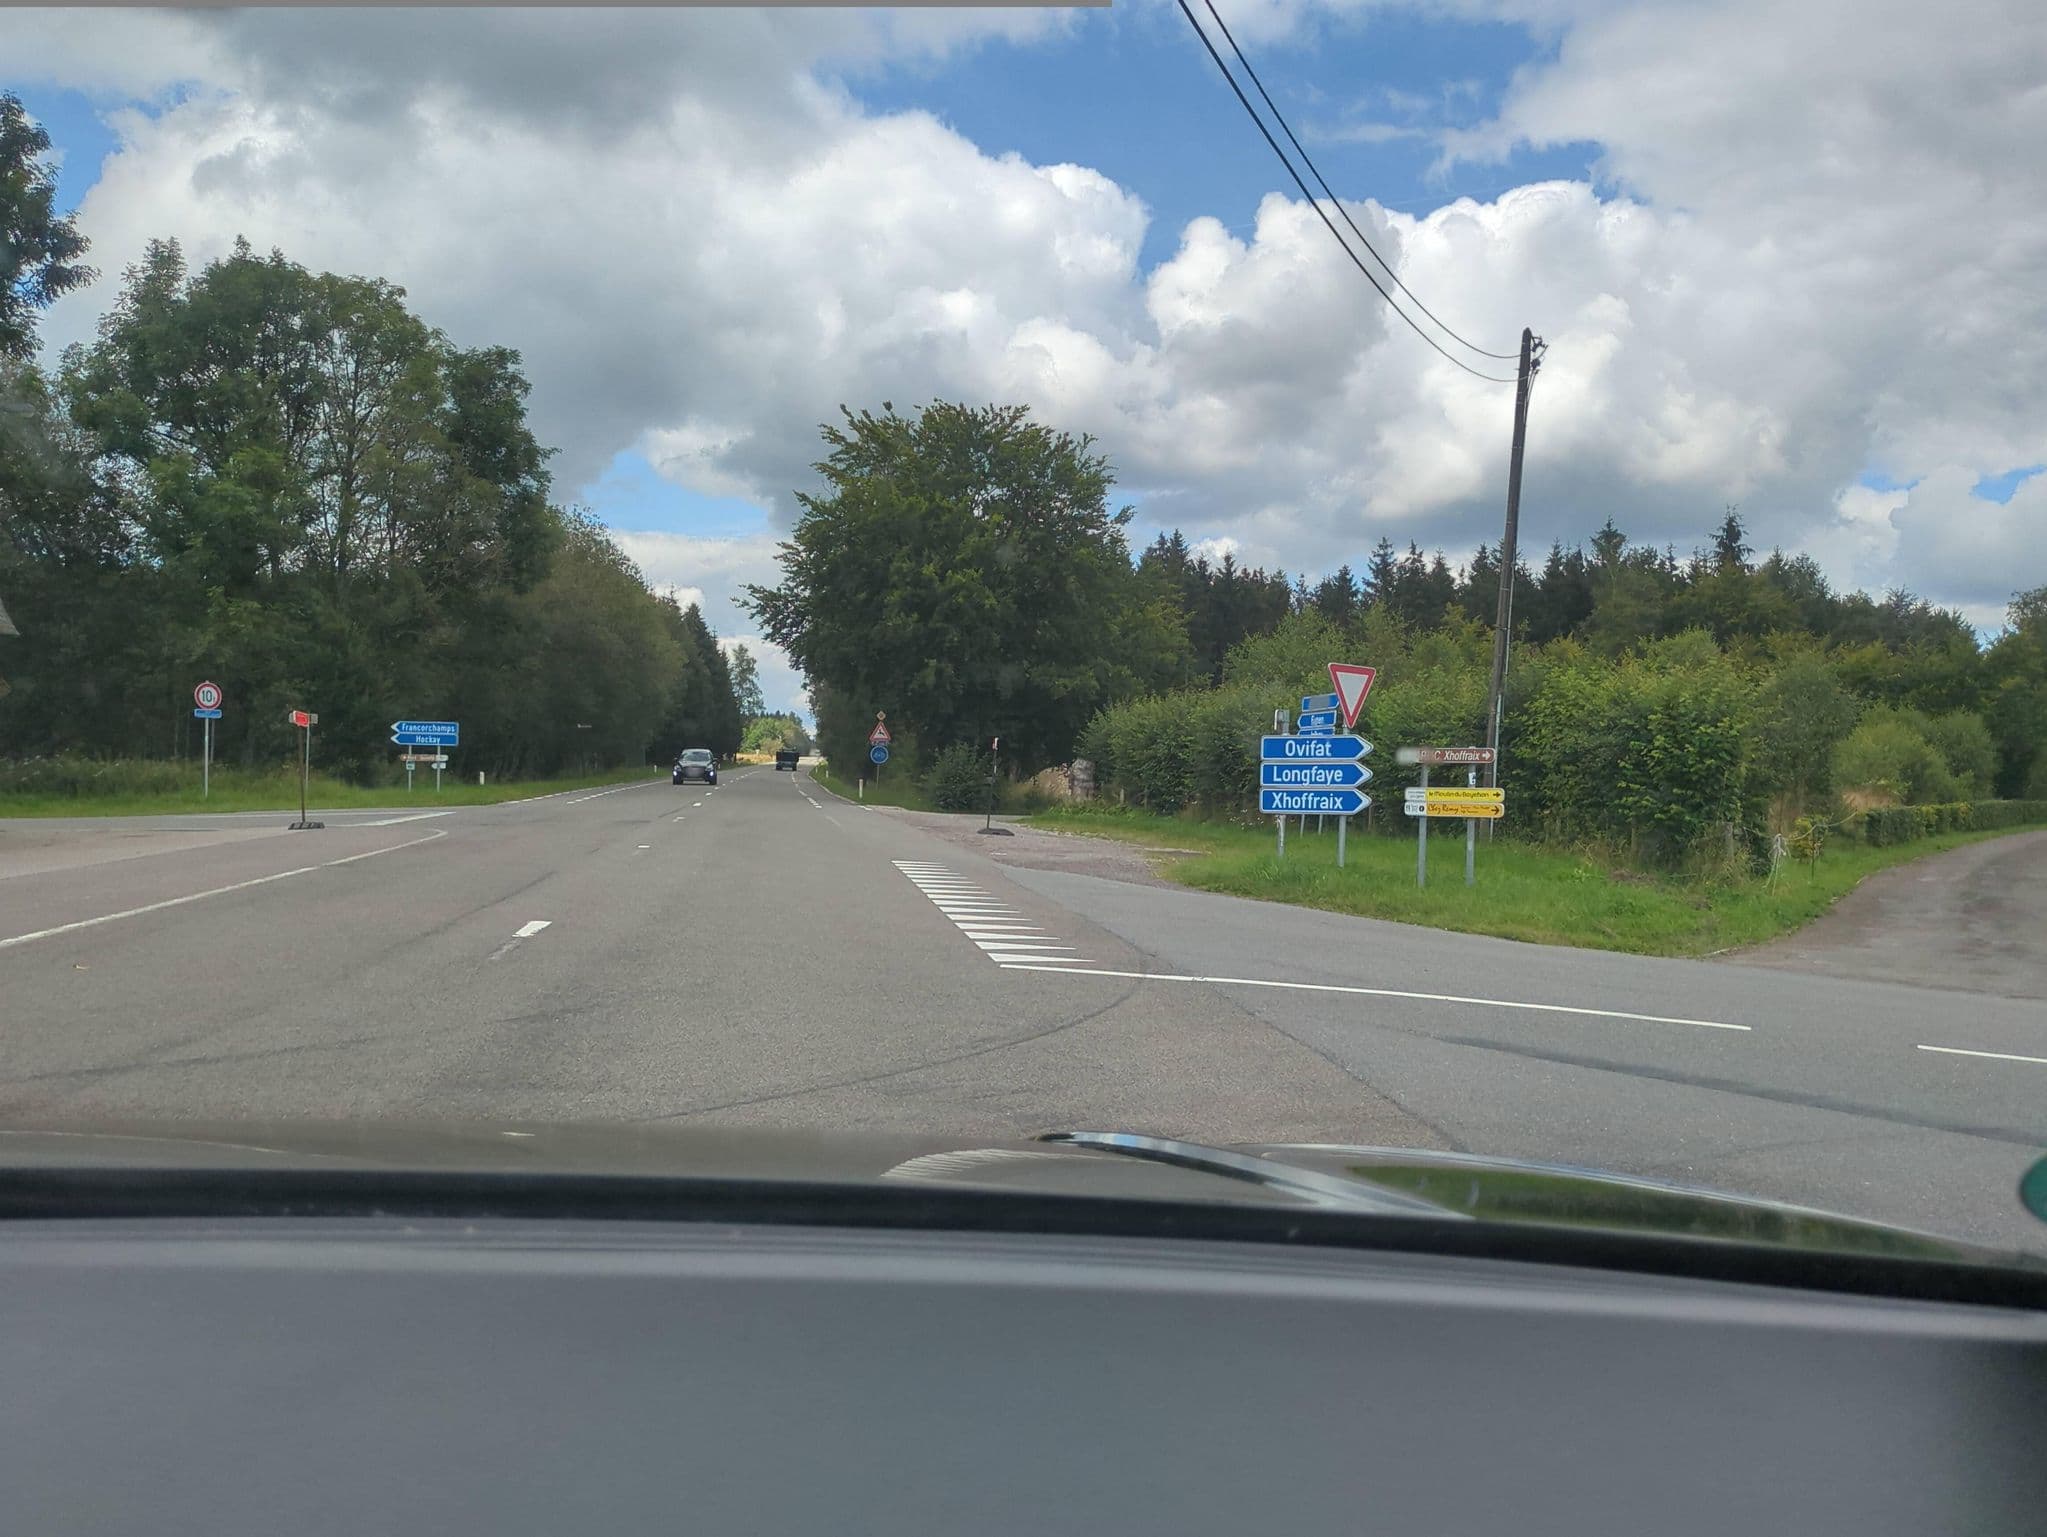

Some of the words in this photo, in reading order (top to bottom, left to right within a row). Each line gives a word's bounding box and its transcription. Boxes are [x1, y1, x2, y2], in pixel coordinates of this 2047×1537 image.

[401, 723, 456, 734] Francorchamps
[415, 735, 441, 745] Hockay
[1284, 739, 1332, 757] Ovifat
[1443, 750, 1480, 761] Xhoffraix
[1273, 765, 1343, 787] Longfaye
[1272, 792, 1344, 809] Xhoffraix
